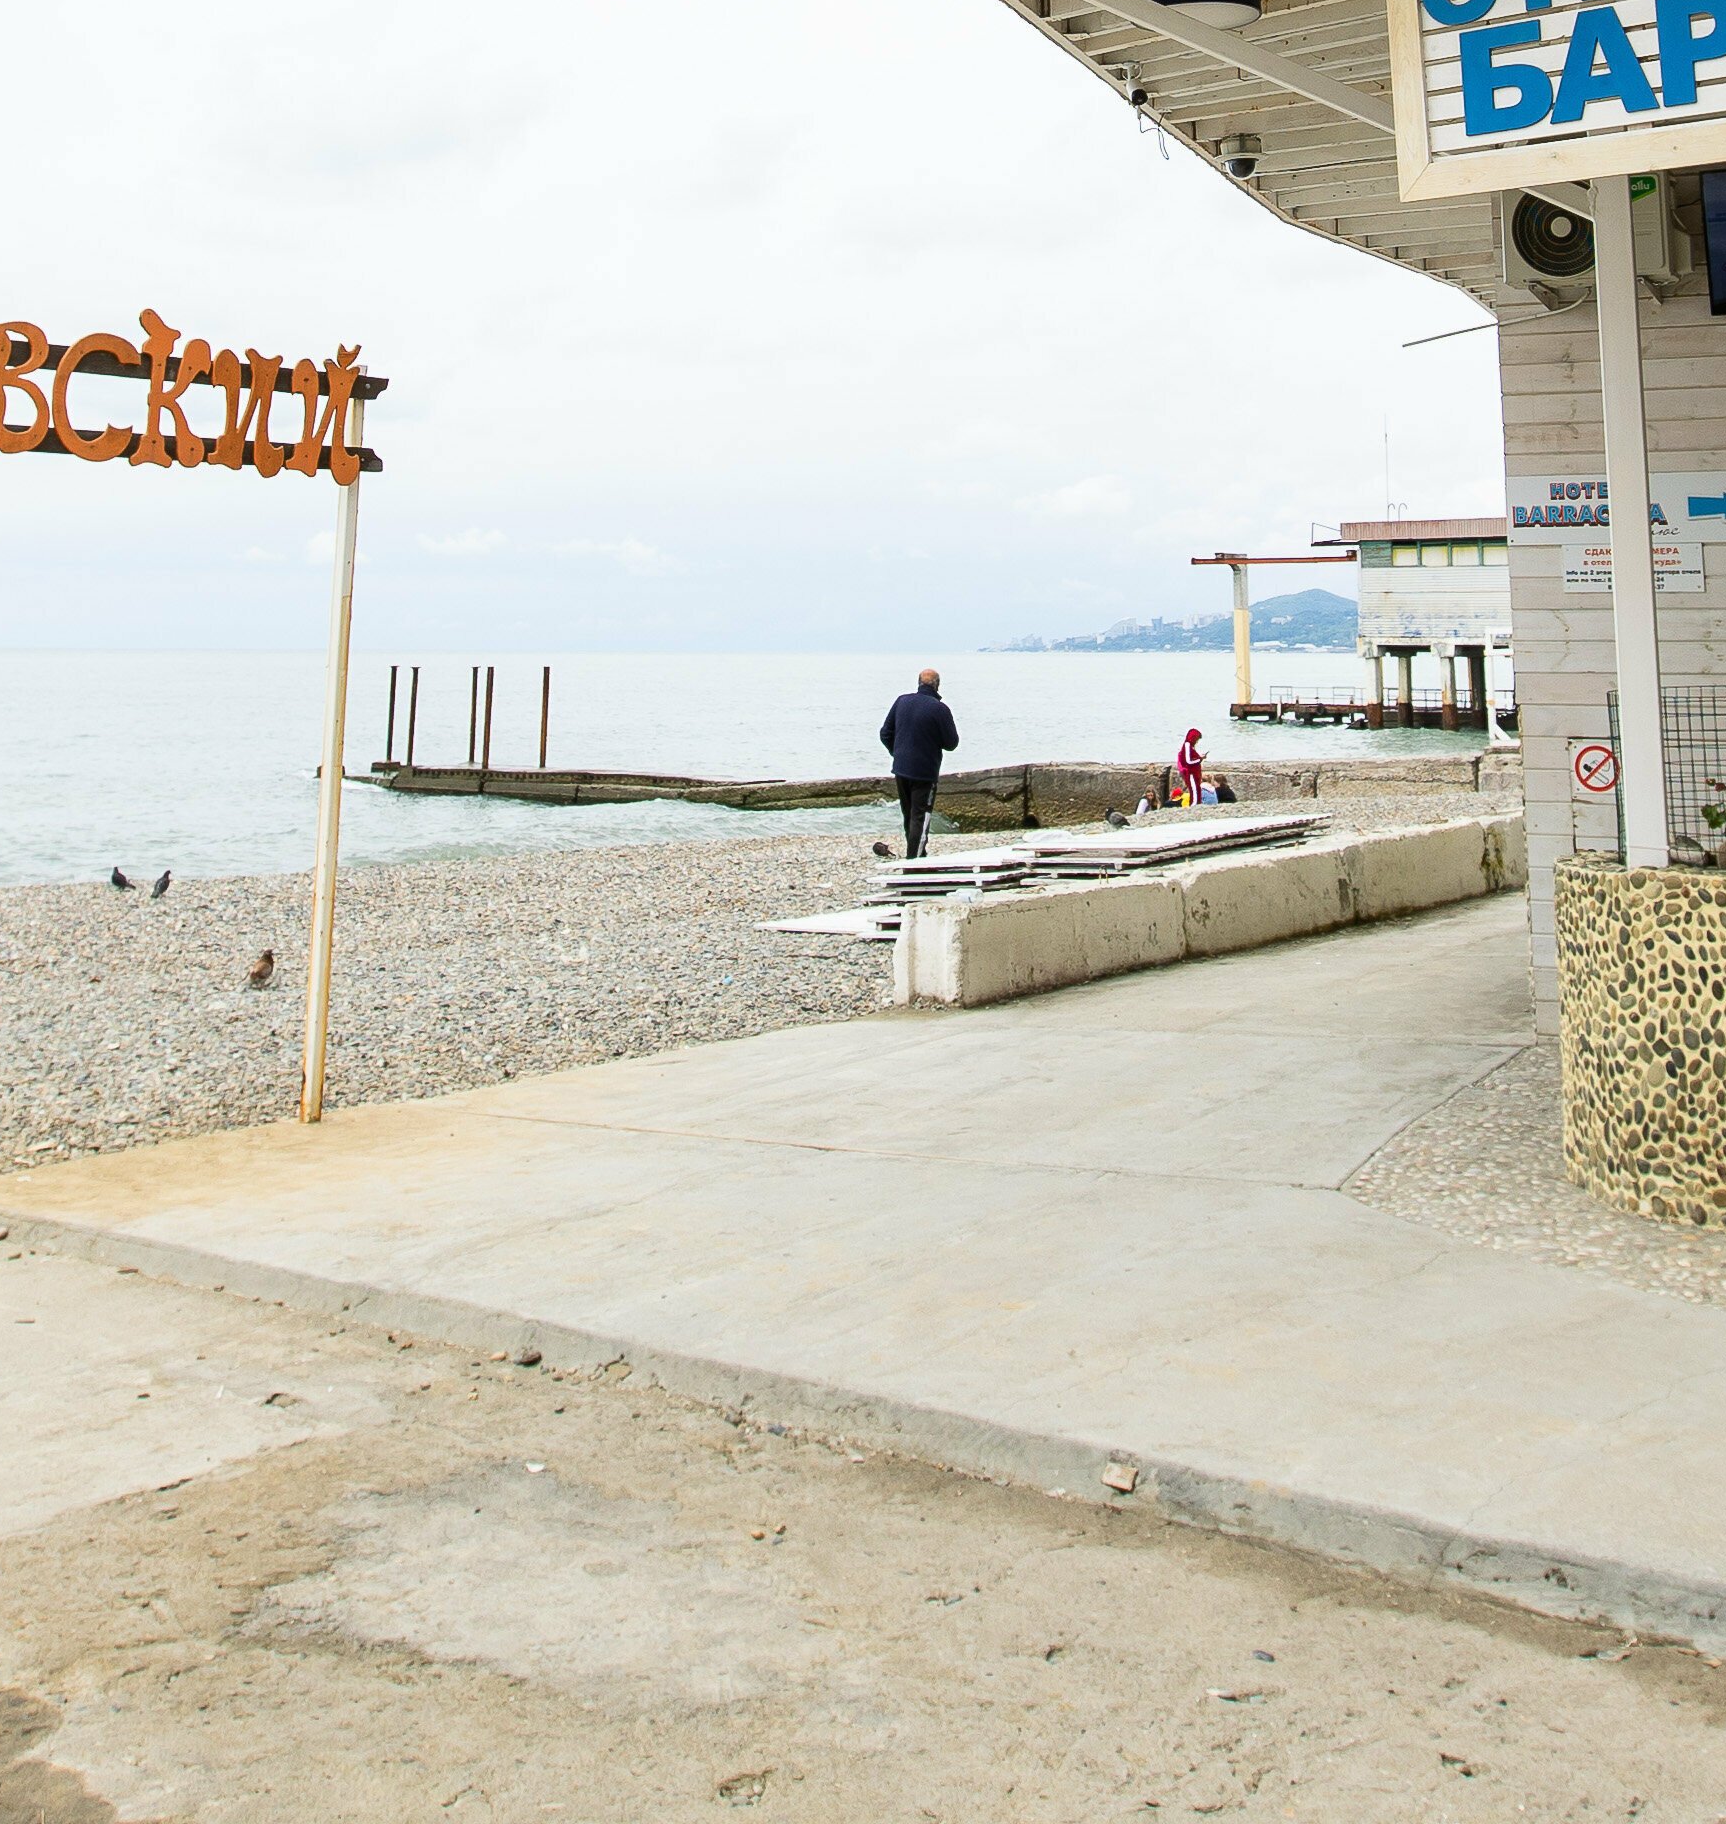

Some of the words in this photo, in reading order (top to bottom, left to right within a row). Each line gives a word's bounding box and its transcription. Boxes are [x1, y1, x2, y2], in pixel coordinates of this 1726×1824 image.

[1631, 179, 1650, 191] allu
[1550, 481, 1609, 500] HOTE
[1512, 502, 1669, 528] BARRACA
[1652, 547, 1680, 555] МЕРА
